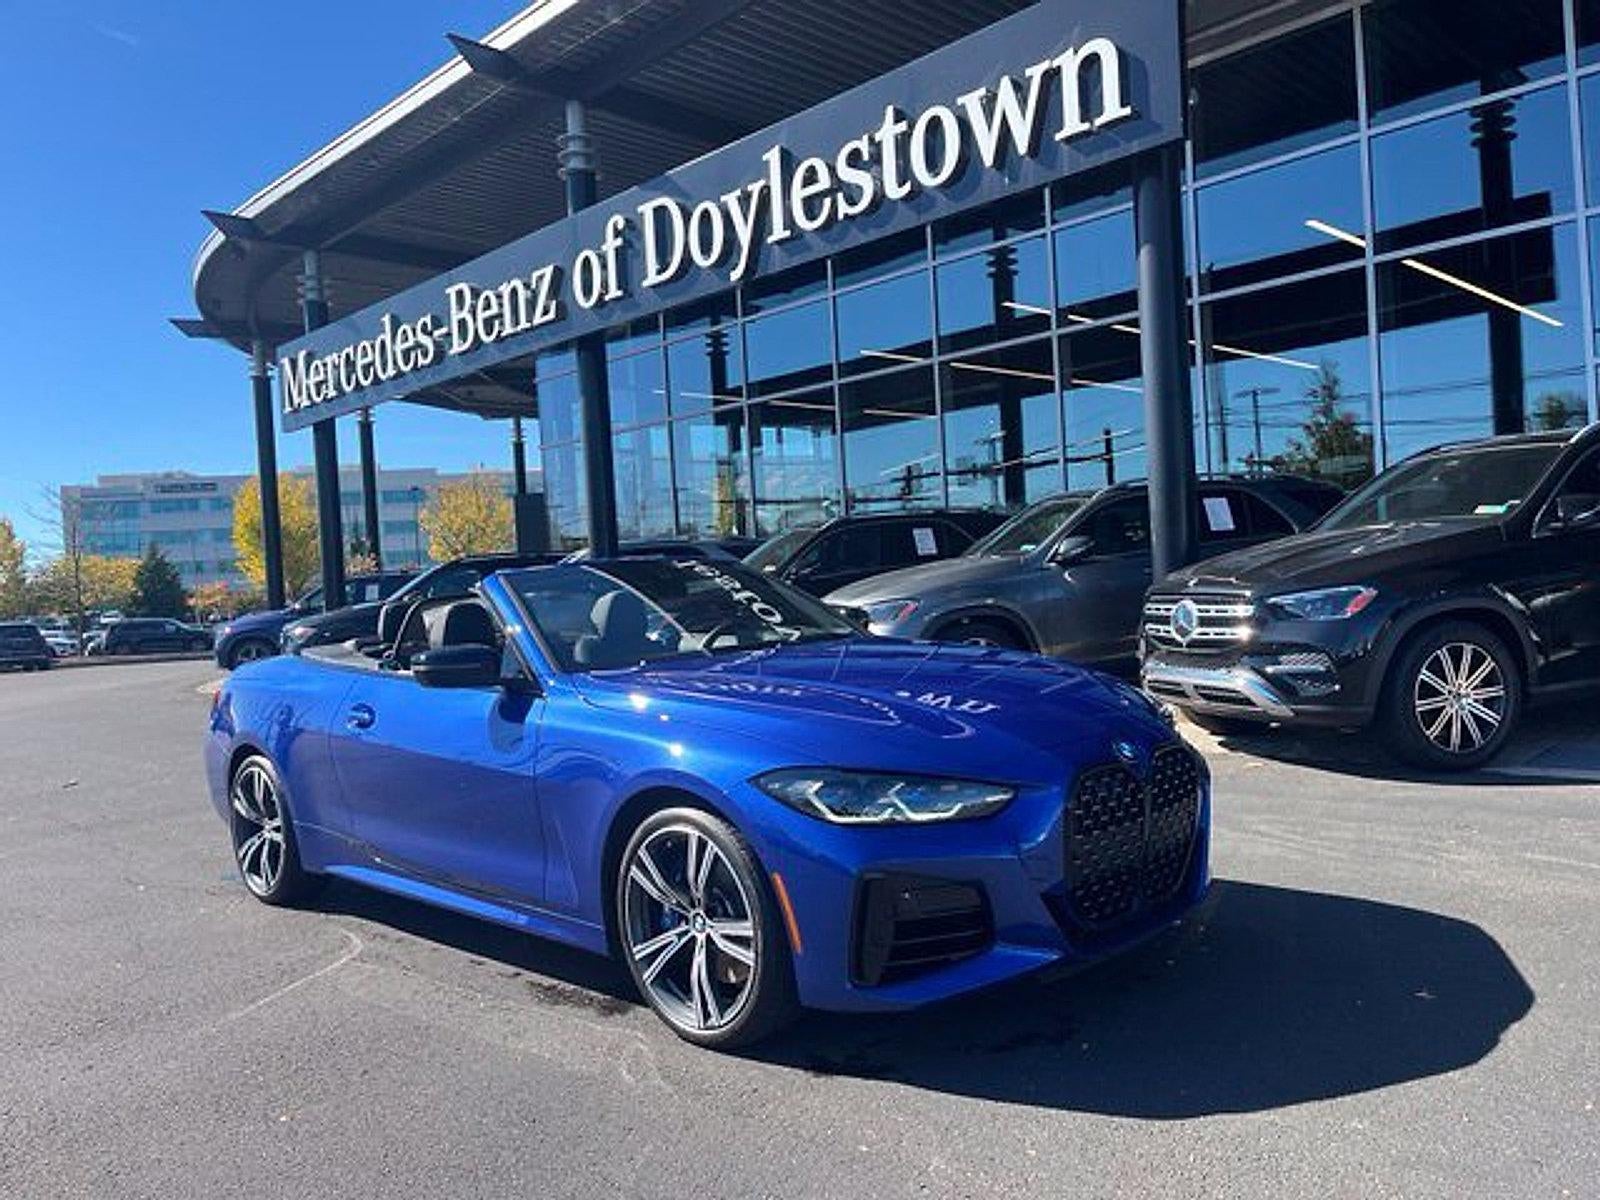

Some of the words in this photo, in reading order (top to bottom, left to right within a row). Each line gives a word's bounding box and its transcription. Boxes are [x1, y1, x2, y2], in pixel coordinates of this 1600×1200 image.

[279, 263, 557, 414] Mercedes-Benz
[572, 214, 625, 309] of
[637, 37, 1132, 288] Doylestown
